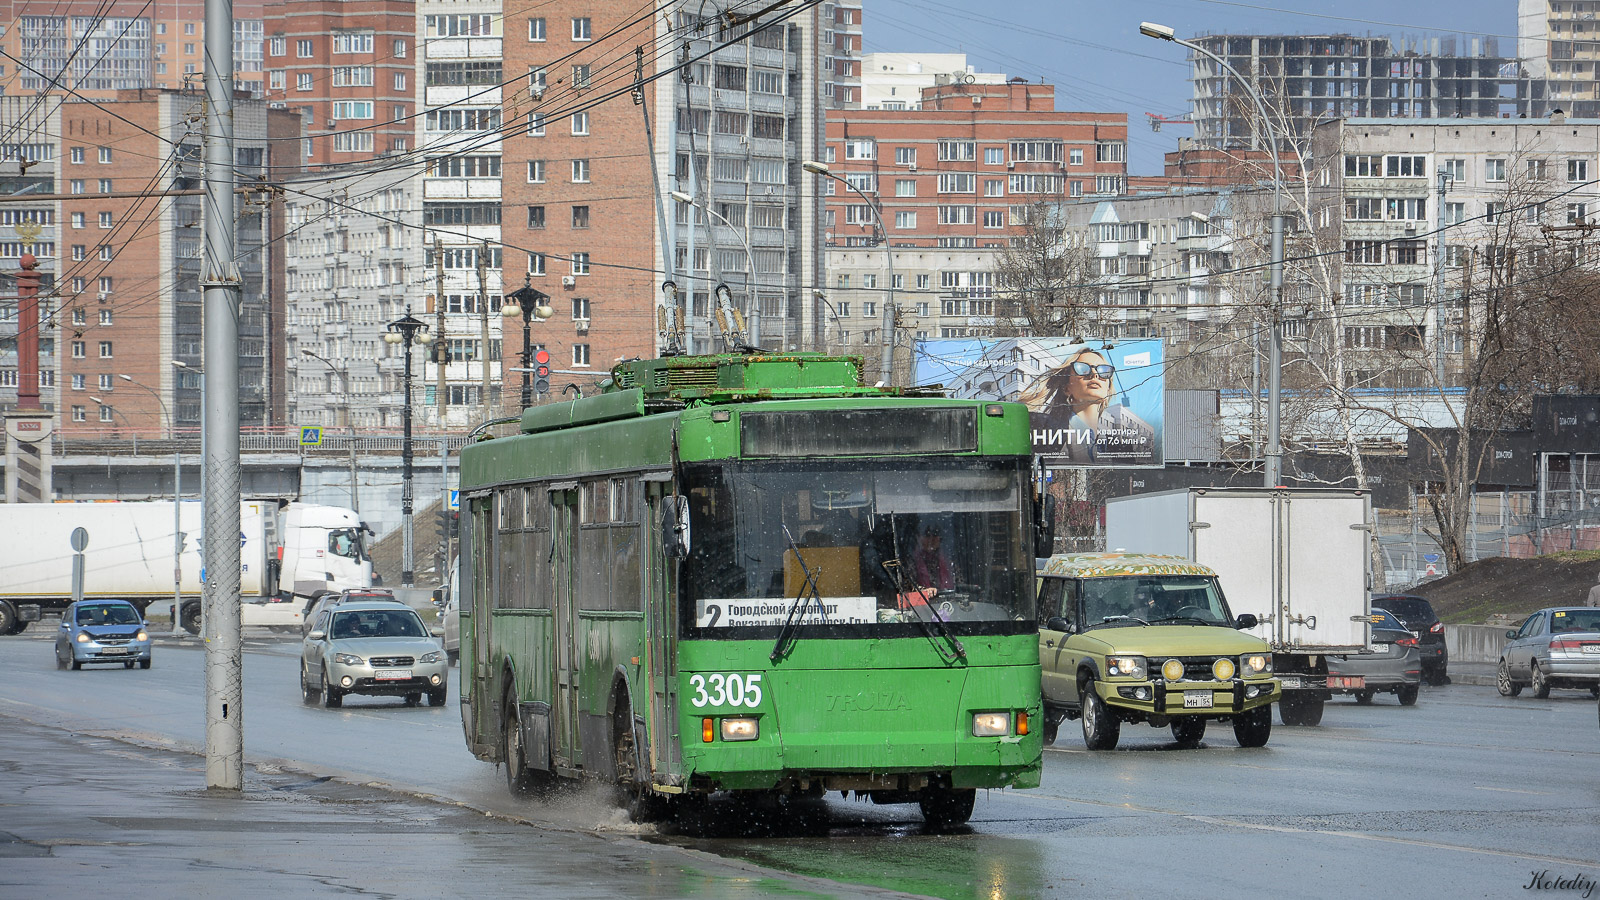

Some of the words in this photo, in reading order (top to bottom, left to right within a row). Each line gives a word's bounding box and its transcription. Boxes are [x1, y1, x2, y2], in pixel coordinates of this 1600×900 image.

[1030, 428, 1090, 445] НИТИ
[1096, 428, 1139, 436] квартиры
[706, 604, 721, 628] 2
[728, 603, 786, 616] Городской
[689, 673, 762, 708] 3305
